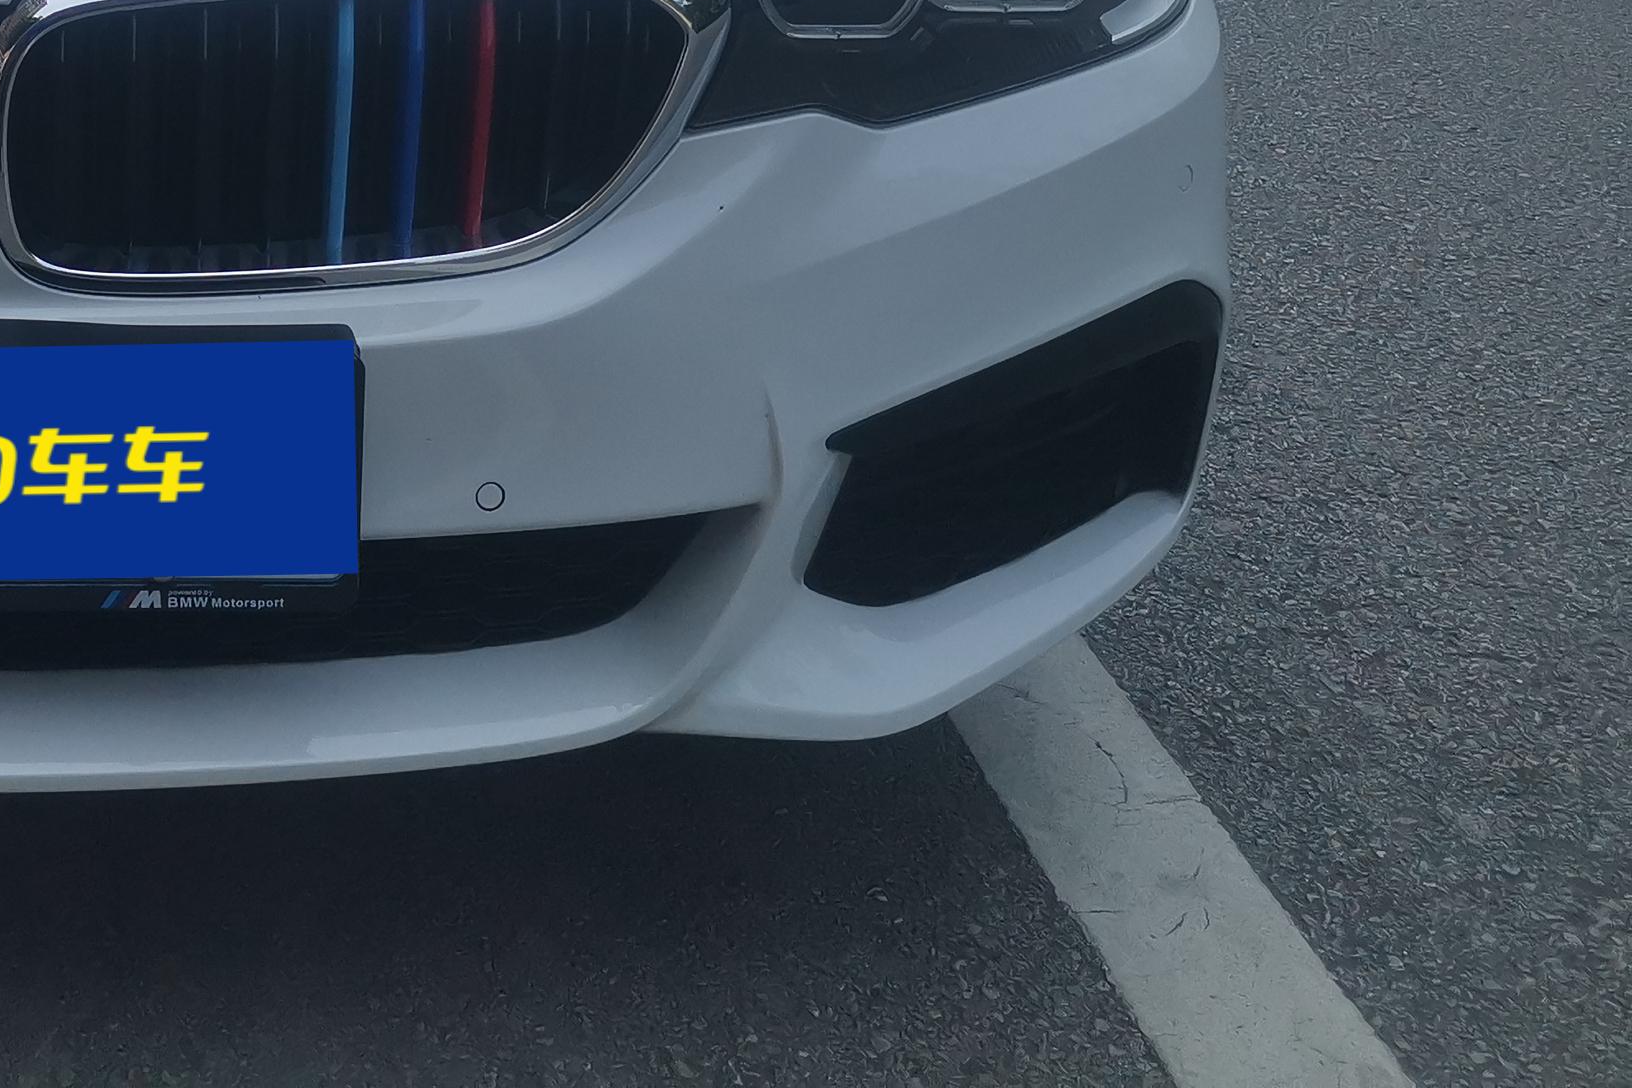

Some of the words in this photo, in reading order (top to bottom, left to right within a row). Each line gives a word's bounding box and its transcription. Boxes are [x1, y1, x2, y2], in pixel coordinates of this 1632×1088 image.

[129, 590, 162, 608] M
[168, 597, 208, 608] BMW
[212, 598, 285, 609] Motorsport
